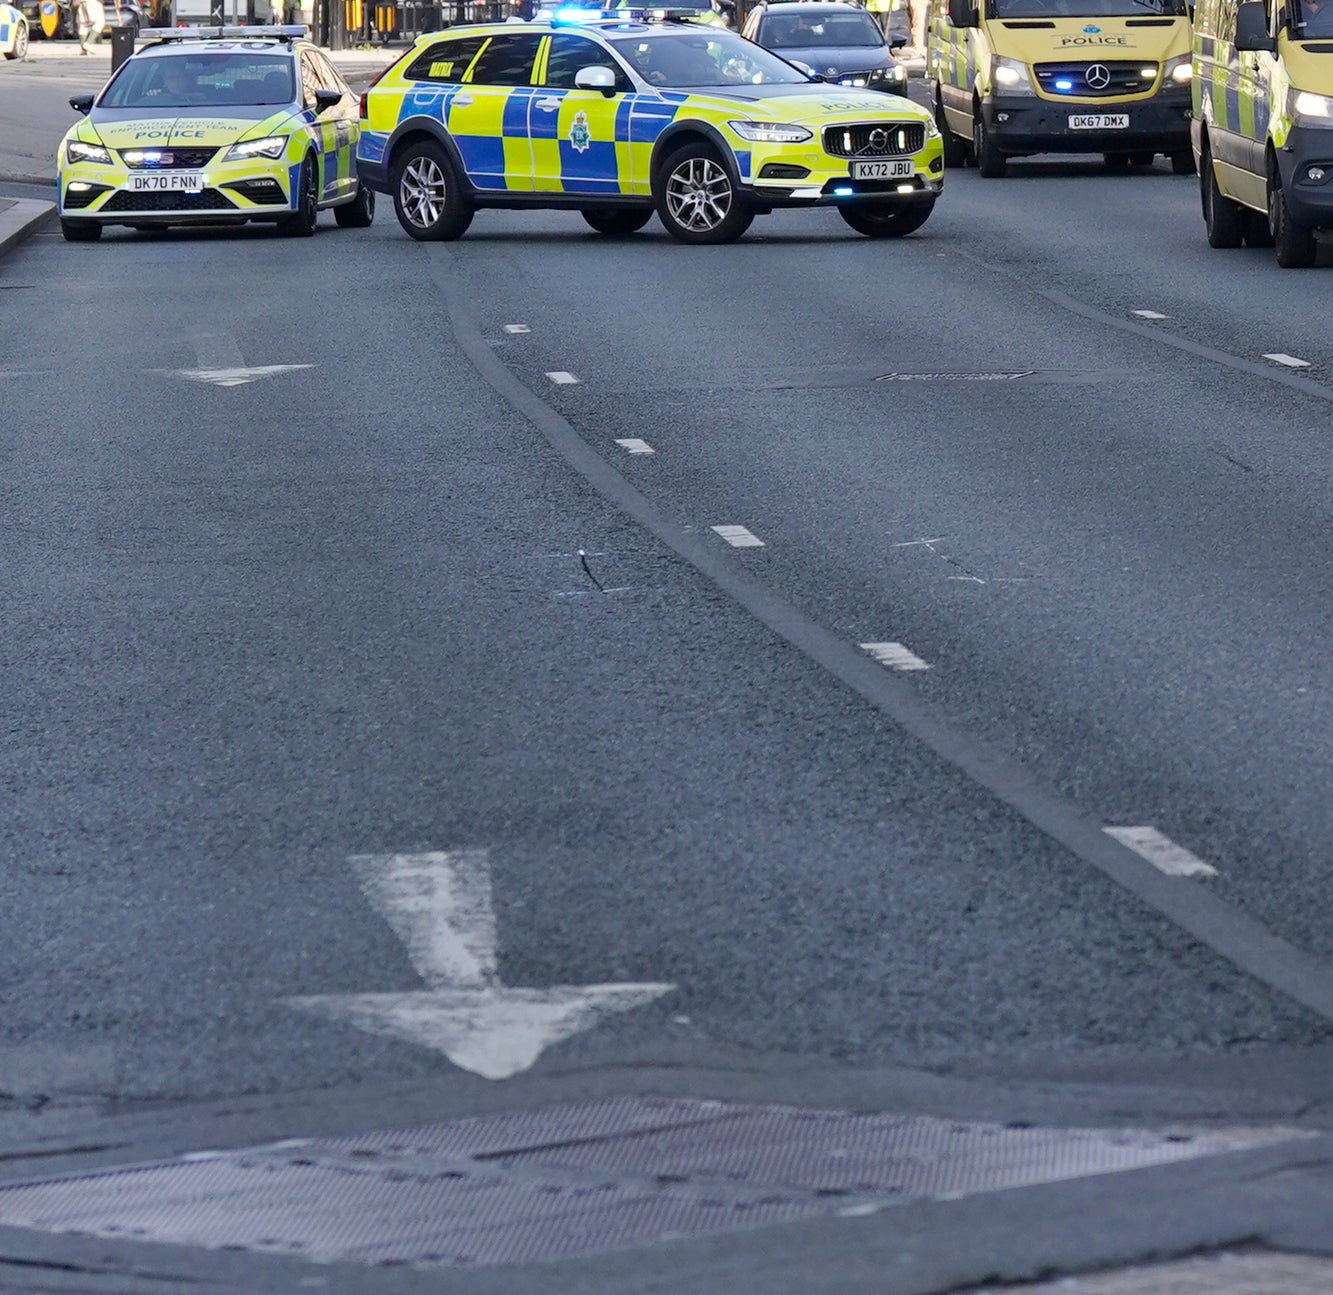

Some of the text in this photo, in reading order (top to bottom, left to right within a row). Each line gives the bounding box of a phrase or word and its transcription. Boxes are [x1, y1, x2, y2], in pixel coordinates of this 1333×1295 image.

[1061, 37, 1127, 46] POLICE
[1073, 116, 1125, 127] DK67 DMX
[135, 130, 206, 140] POLICE
[860, 163, 911, 177] KX72 JBU
[134, 176, 197, 189] DK70 FNN
